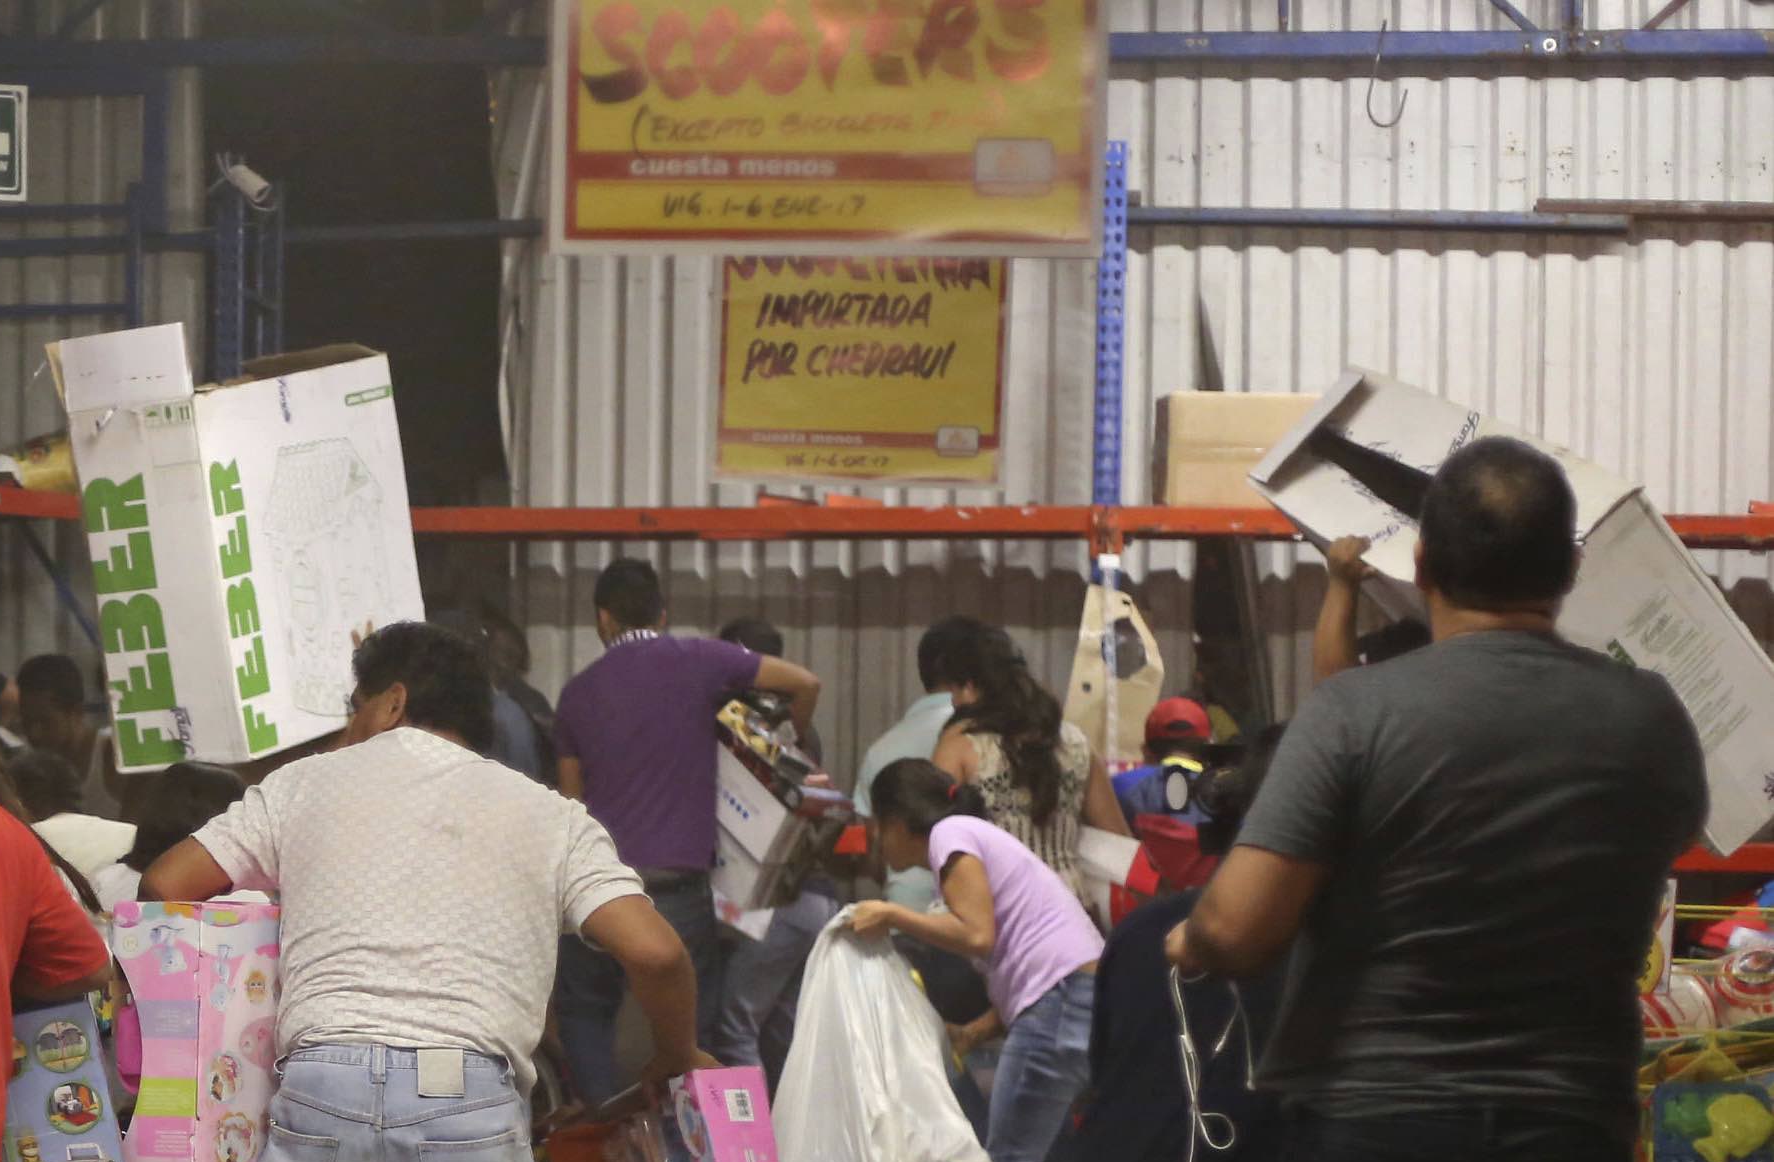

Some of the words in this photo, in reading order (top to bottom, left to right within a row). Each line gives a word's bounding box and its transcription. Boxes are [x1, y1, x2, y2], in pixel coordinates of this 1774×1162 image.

[629, 156, 730, 177] cuesta
[738, 158, 838, 177] menos
[754, 289, 933, 330] IMPORTADA
[741, 339, 799, 385] POR
[806, 340, 957, 380] CHEDRAUI
[84, 472, 178, 767] FEBER
[209, 457, 278, 754] FEBER
